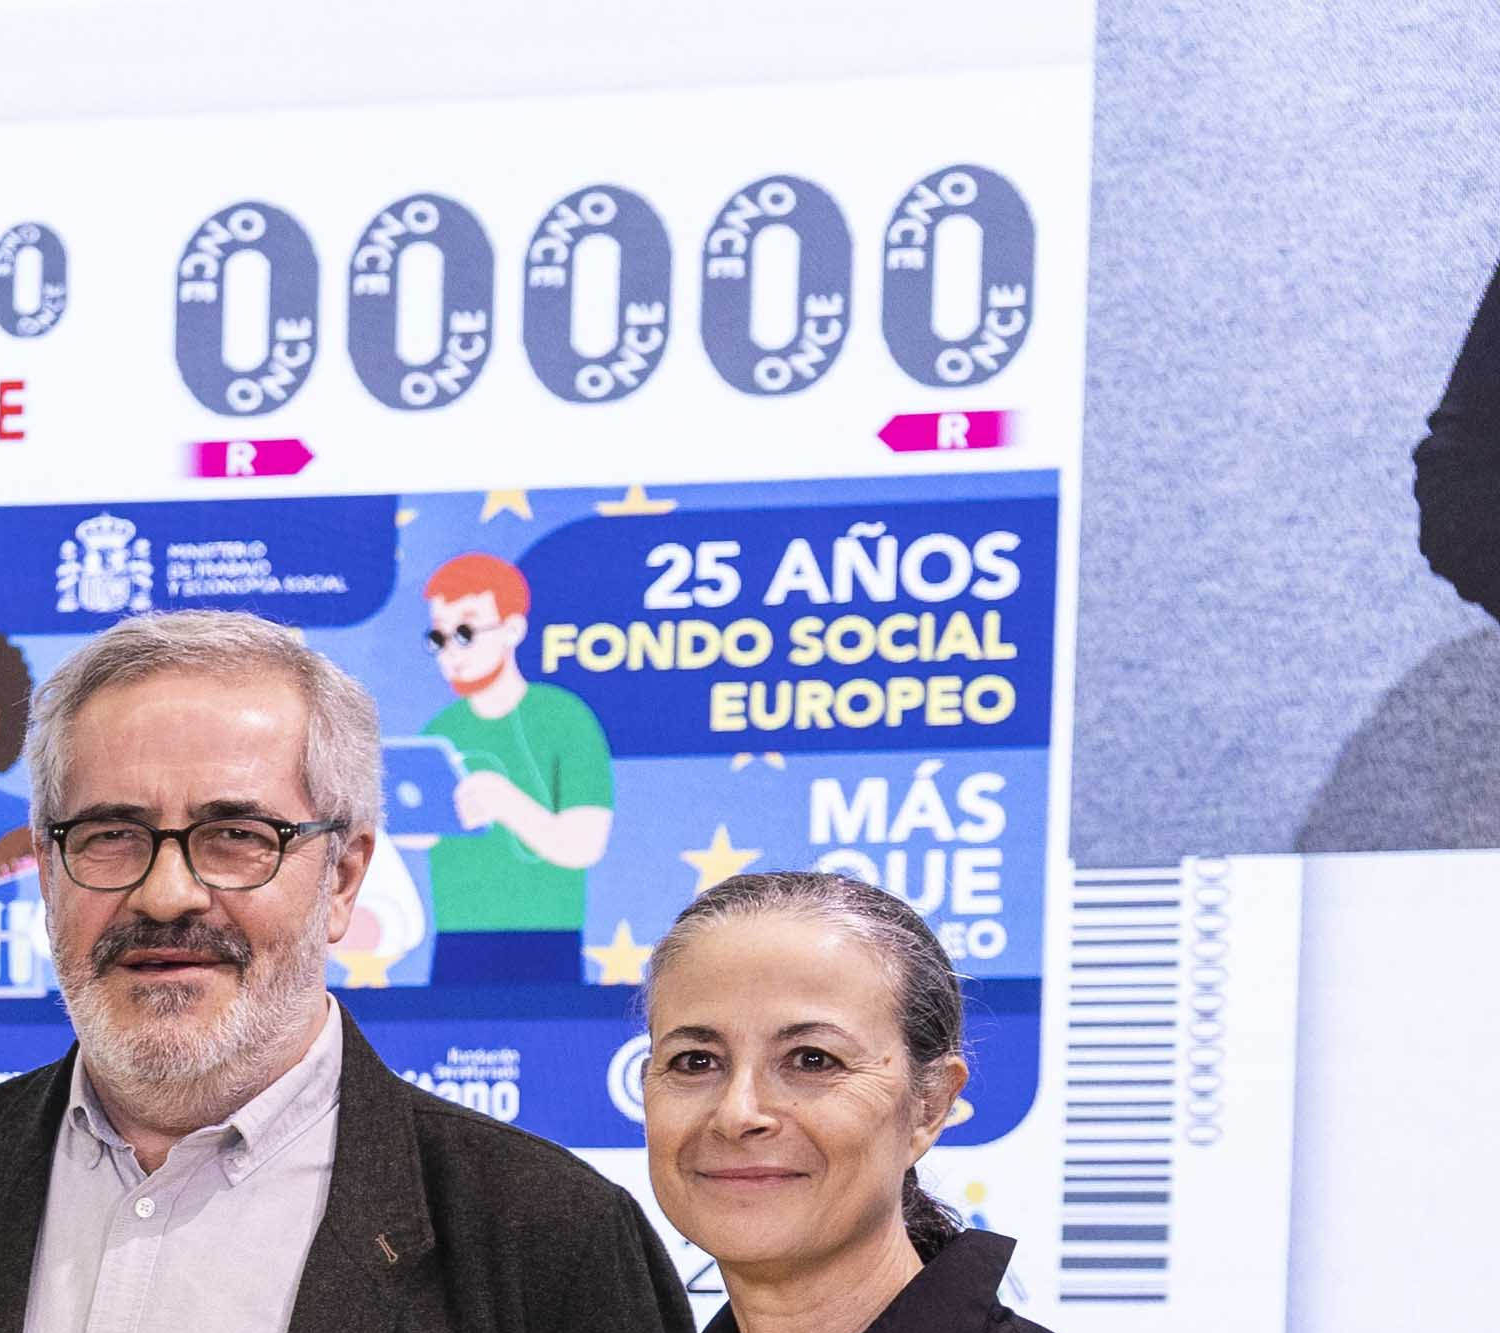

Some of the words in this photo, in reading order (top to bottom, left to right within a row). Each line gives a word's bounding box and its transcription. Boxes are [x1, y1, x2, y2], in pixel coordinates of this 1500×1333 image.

[226, 442, 257, 476] R
[937, 413, 970, 449] R
[644, 541, 742, 610] 25
[763, 520, 1021, 606] AÑOS
[542, 618, 774, 674] FONDO
[789, 610, 1018, 667] SOCIAL
[709, 674, 1016, 733] EUROPEO
[809, 759, 1007, 844] MÁS
